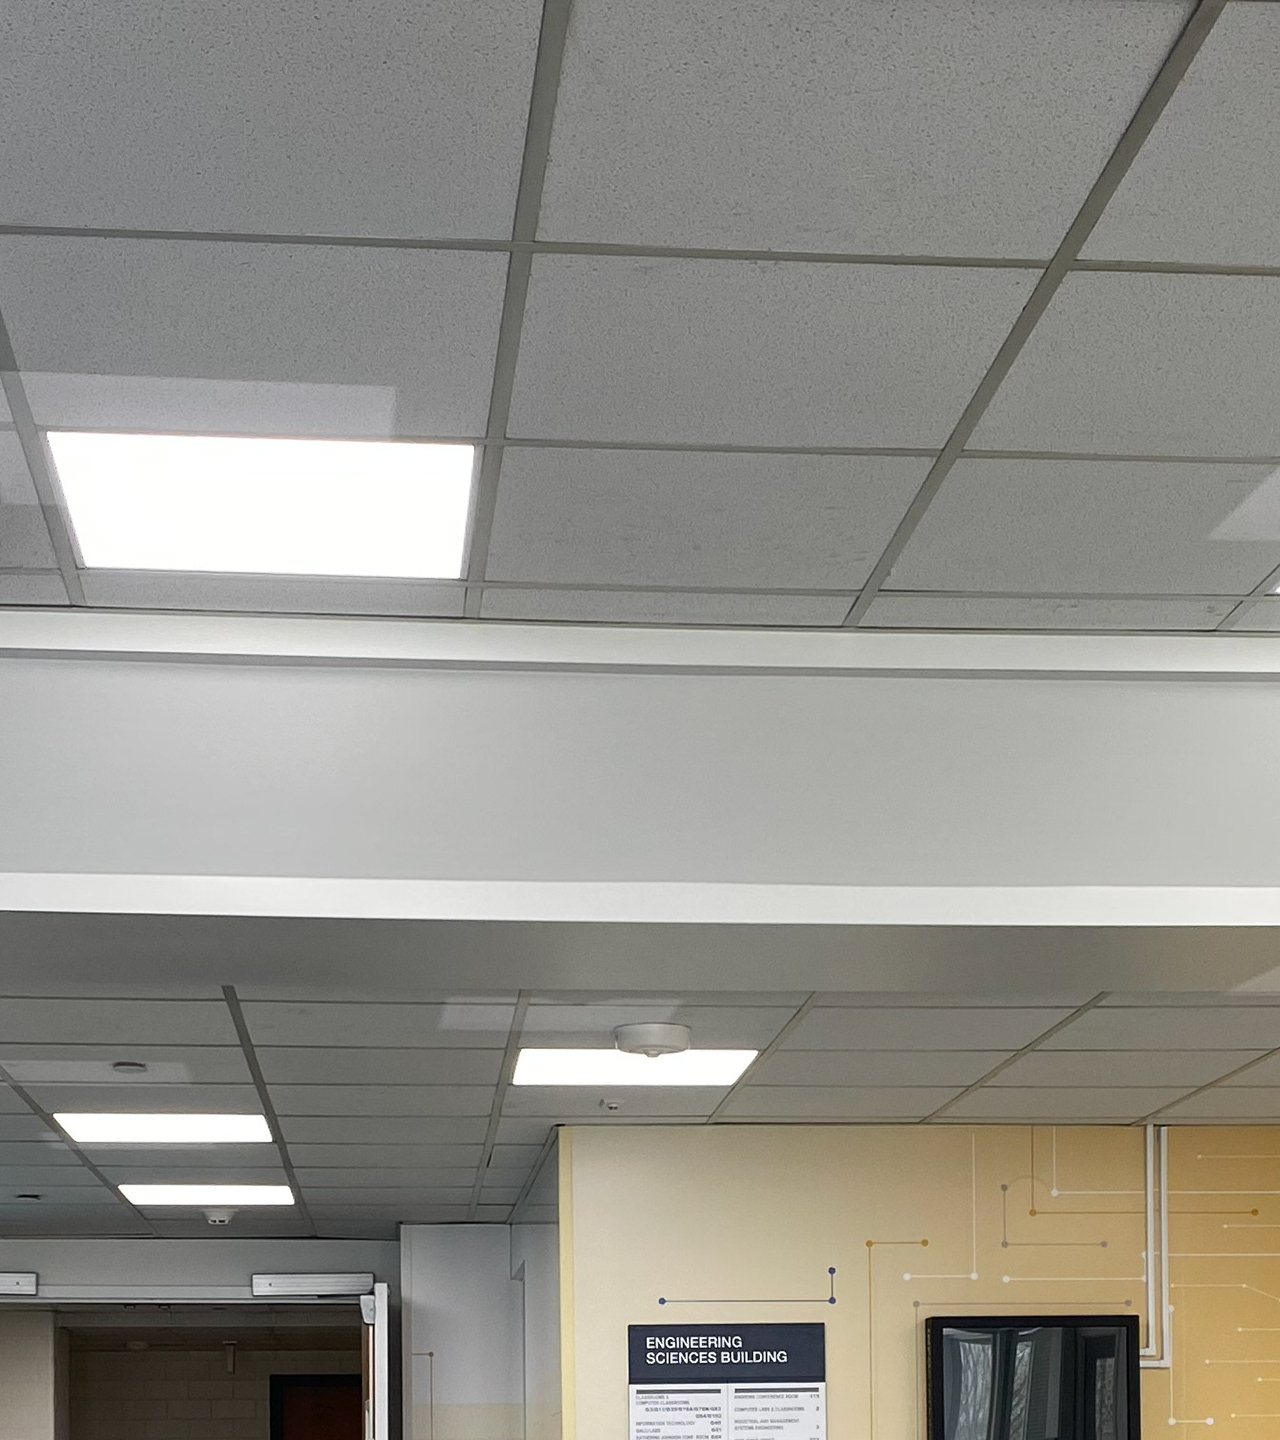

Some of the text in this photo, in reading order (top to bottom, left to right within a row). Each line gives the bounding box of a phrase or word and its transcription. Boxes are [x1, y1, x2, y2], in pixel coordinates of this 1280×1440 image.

[646, 1336, 742, 1349] ENGINEERING
[646, 1351, 788, 1364] SCIENCES BUILDING
